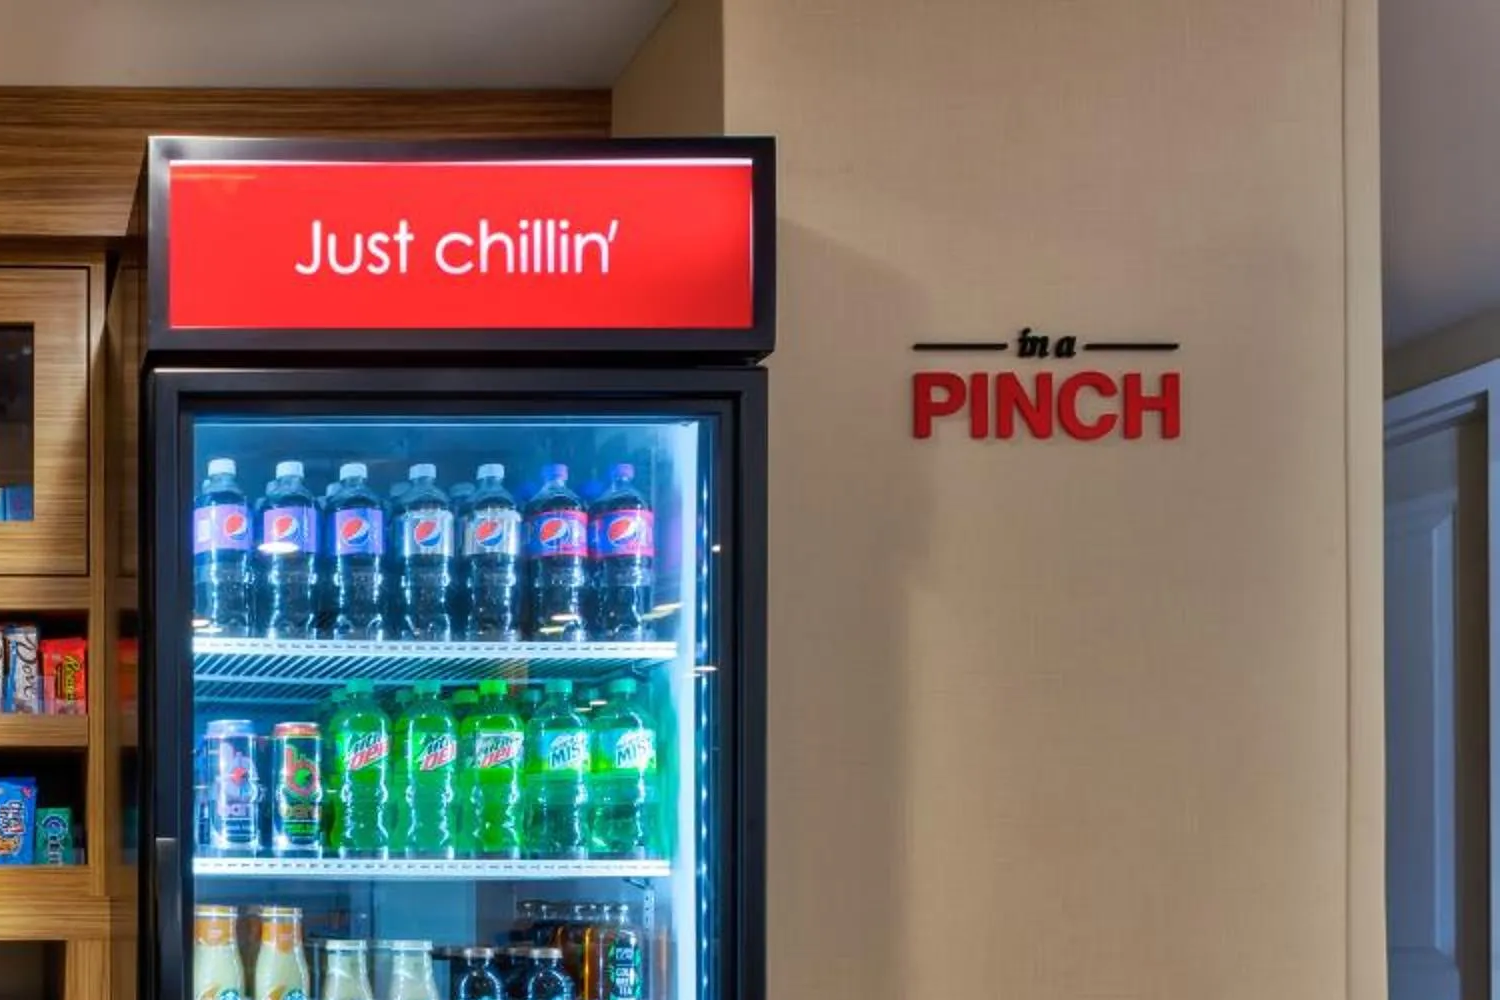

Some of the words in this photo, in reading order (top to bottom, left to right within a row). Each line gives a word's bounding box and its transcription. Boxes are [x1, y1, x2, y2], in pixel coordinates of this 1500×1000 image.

[295, 219, 413, 274] Just
[435, 219, 620, 275] chillin'
[1017, 327, 1049, 358] in
[1054, 336, 1077, 358] a
[912, 371, 1181, 440] PINCH
